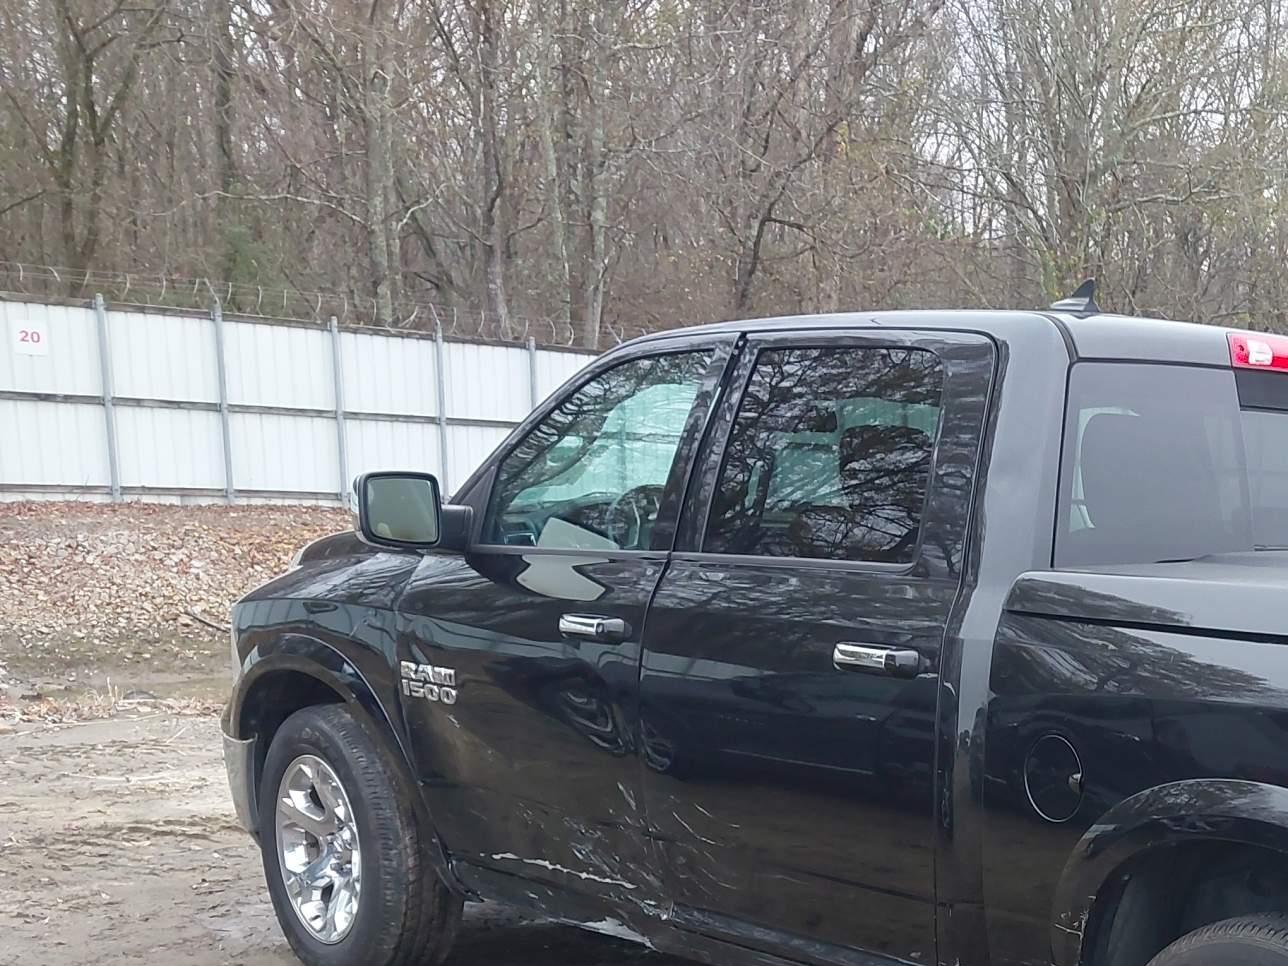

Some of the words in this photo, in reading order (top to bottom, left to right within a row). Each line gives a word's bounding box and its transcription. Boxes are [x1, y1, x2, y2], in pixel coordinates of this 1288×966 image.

[19, 329, 41, 344] 20
[400, 660, 456, 686] RAM
[401, 679, 458, 705] 1500
